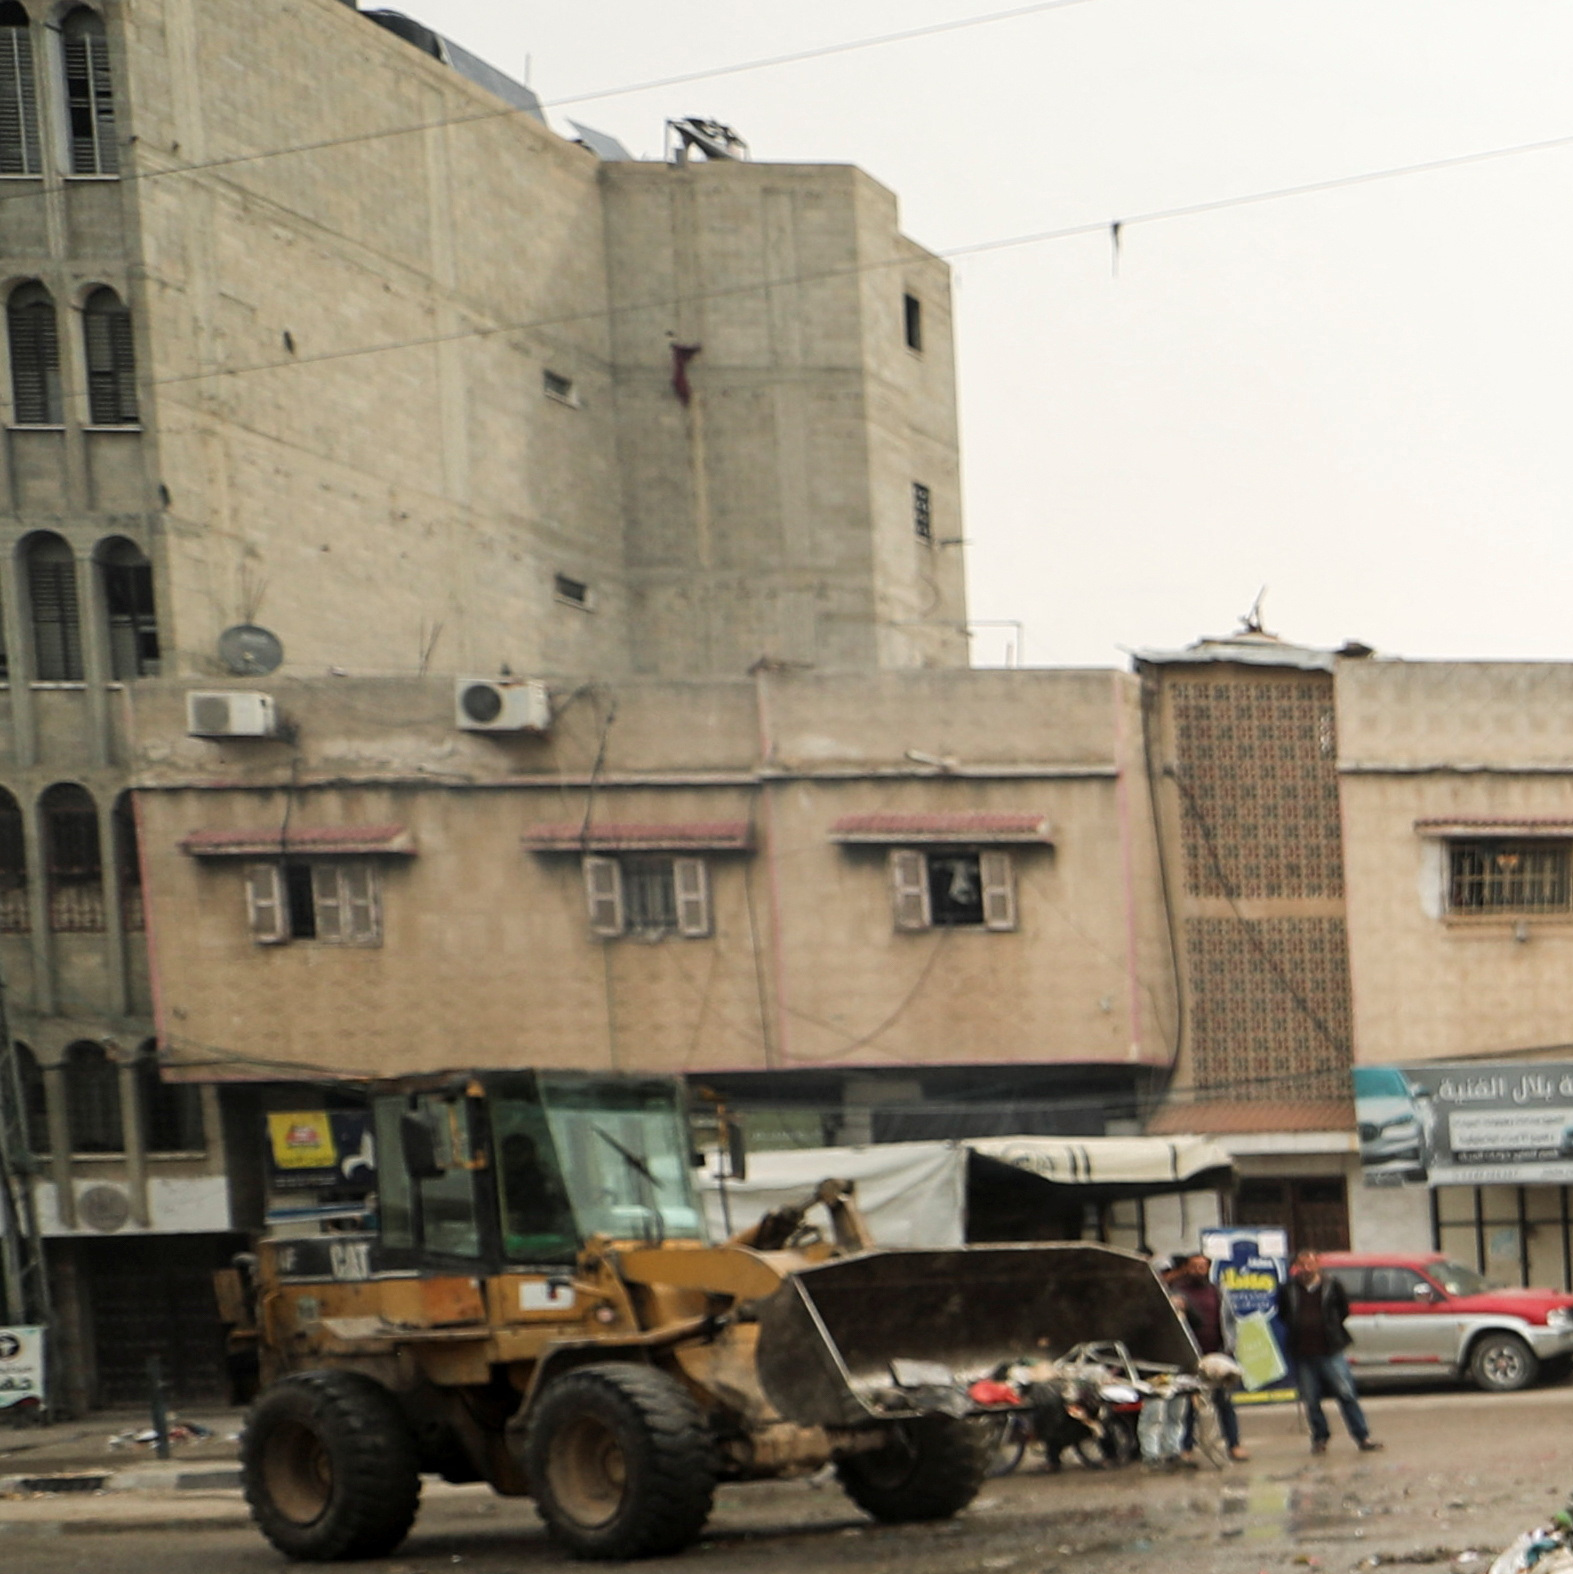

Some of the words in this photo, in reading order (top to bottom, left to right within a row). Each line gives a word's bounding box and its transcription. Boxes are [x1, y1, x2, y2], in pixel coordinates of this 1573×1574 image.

[1438, 1074, 1504, 1105] الفنية
[1511, 1074, 1552, 1105] بلال
[331, 1242, 370, 1279] CAT
